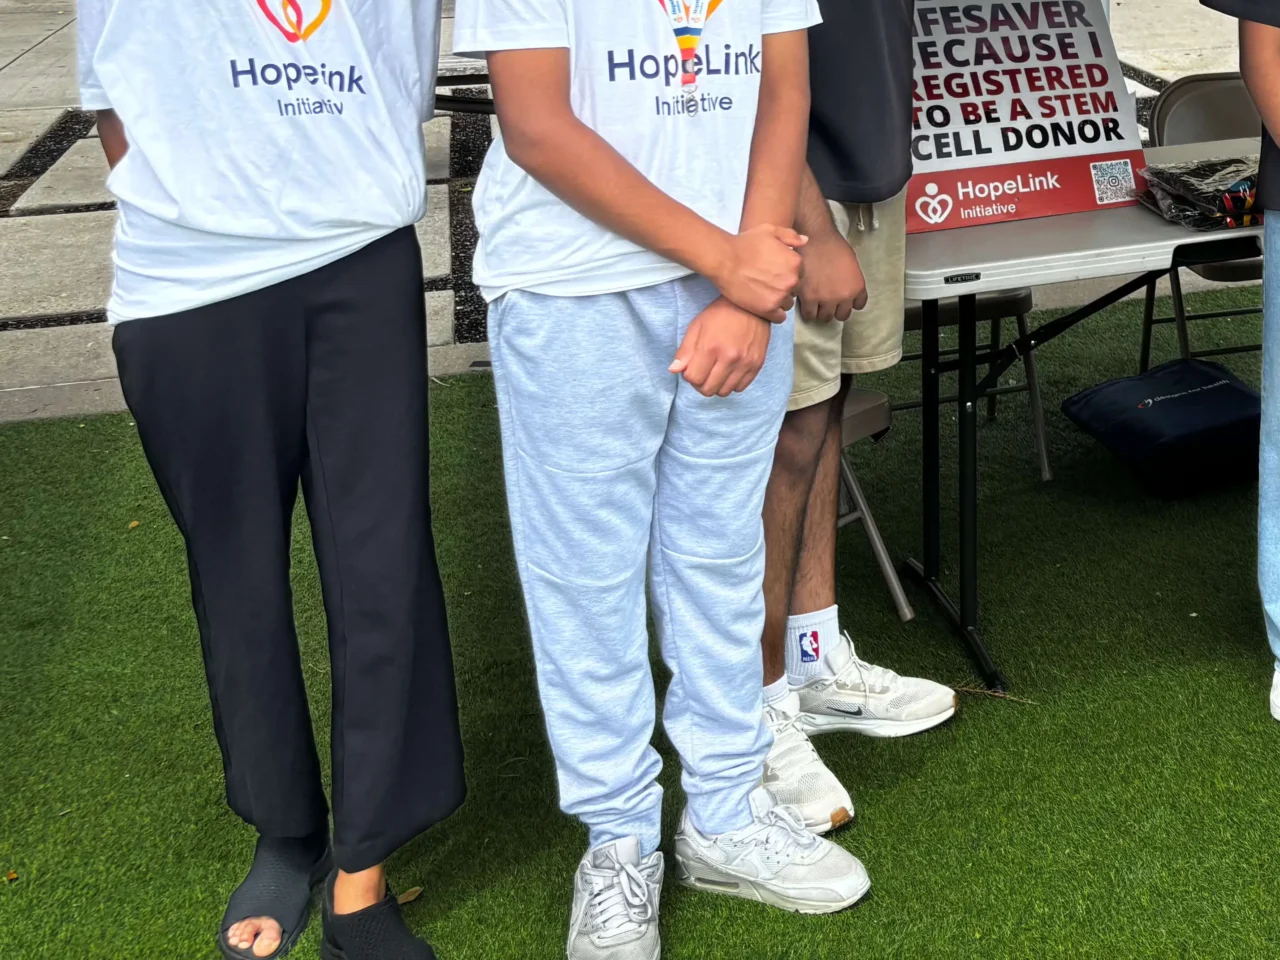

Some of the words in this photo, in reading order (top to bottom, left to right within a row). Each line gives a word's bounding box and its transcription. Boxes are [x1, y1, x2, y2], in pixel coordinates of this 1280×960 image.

[912, 32, 1078, 69] ECAUSE
[1092, 31, 1103, 58] I
[230, 58, 366, 94] Hopeink
[278, 98, 343, 116] Initiativ
[655, 93, 733, 116] Initiative
[959, 99, 1000, 125] BE
[1010, 98, 1032, 122] A
[1040, 91, 1119, 118] STEM
[912, 128, 992, 161] CELL
[1000, 117, 1124, 152] DONOR
[957, 171, 1061, 201] HopeLink
[960, 202, 1016, 219] Initiative
